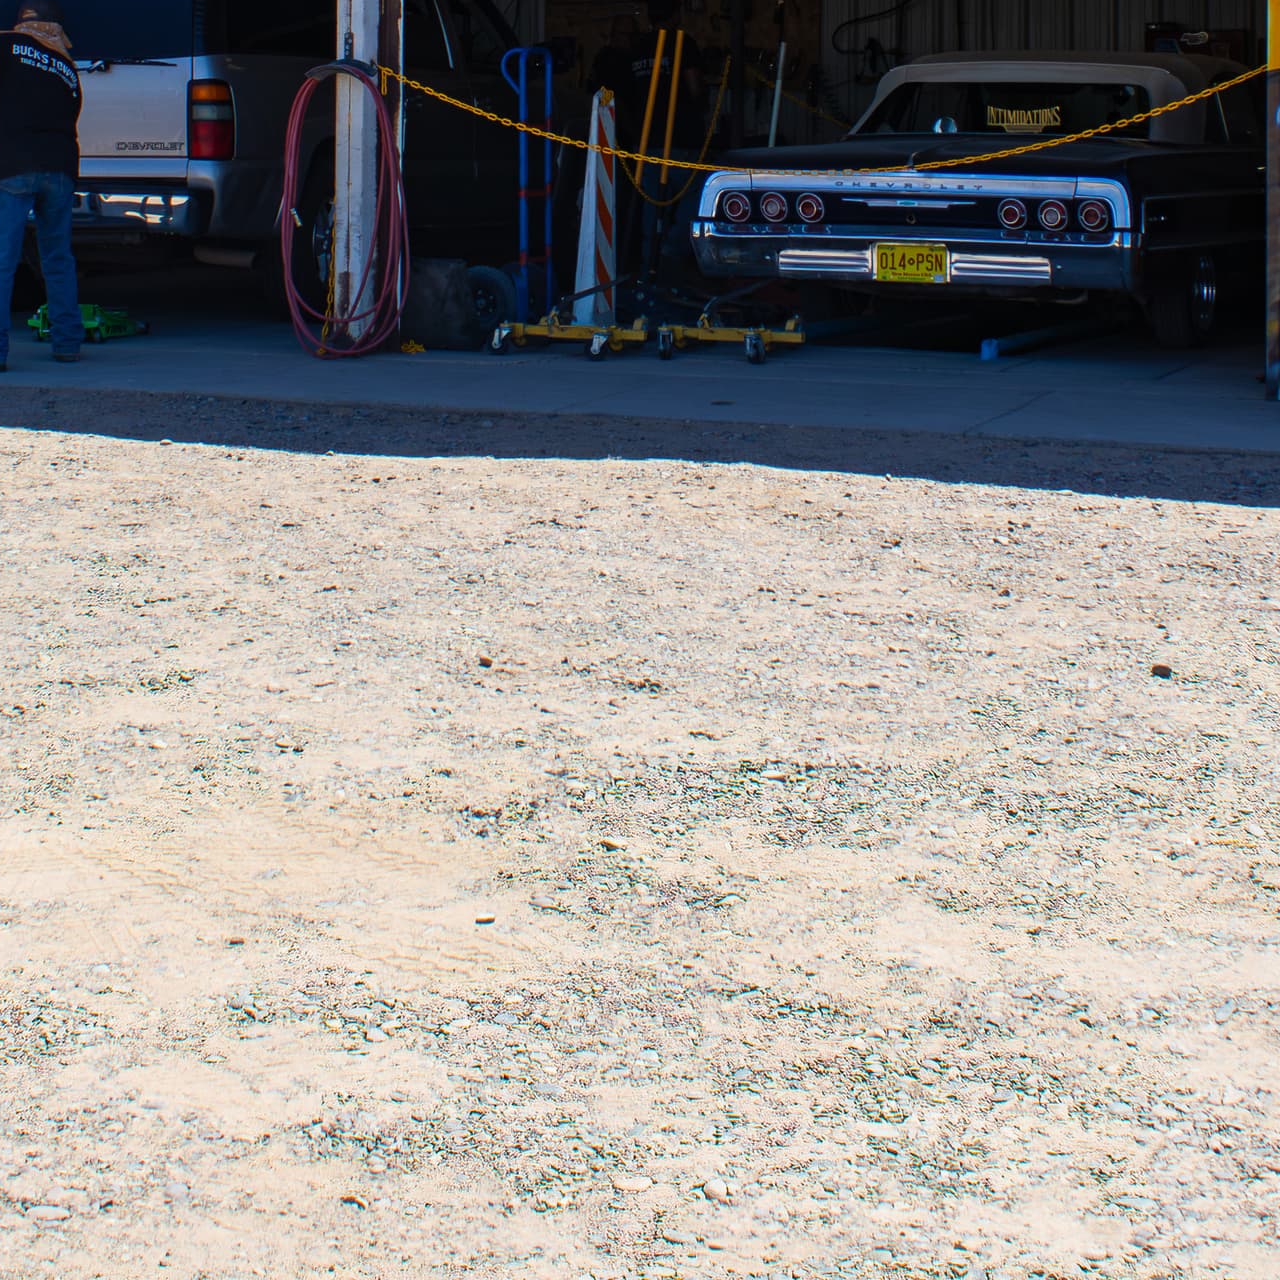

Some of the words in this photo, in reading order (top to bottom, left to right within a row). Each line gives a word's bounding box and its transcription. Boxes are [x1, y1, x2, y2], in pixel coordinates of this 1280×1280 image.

[986, 105, 1062, 126] INTIMIDATIONS
[115, 141, 185, 151] CHEVROLET
[834, 180, 984, 191] CHEVROLET
